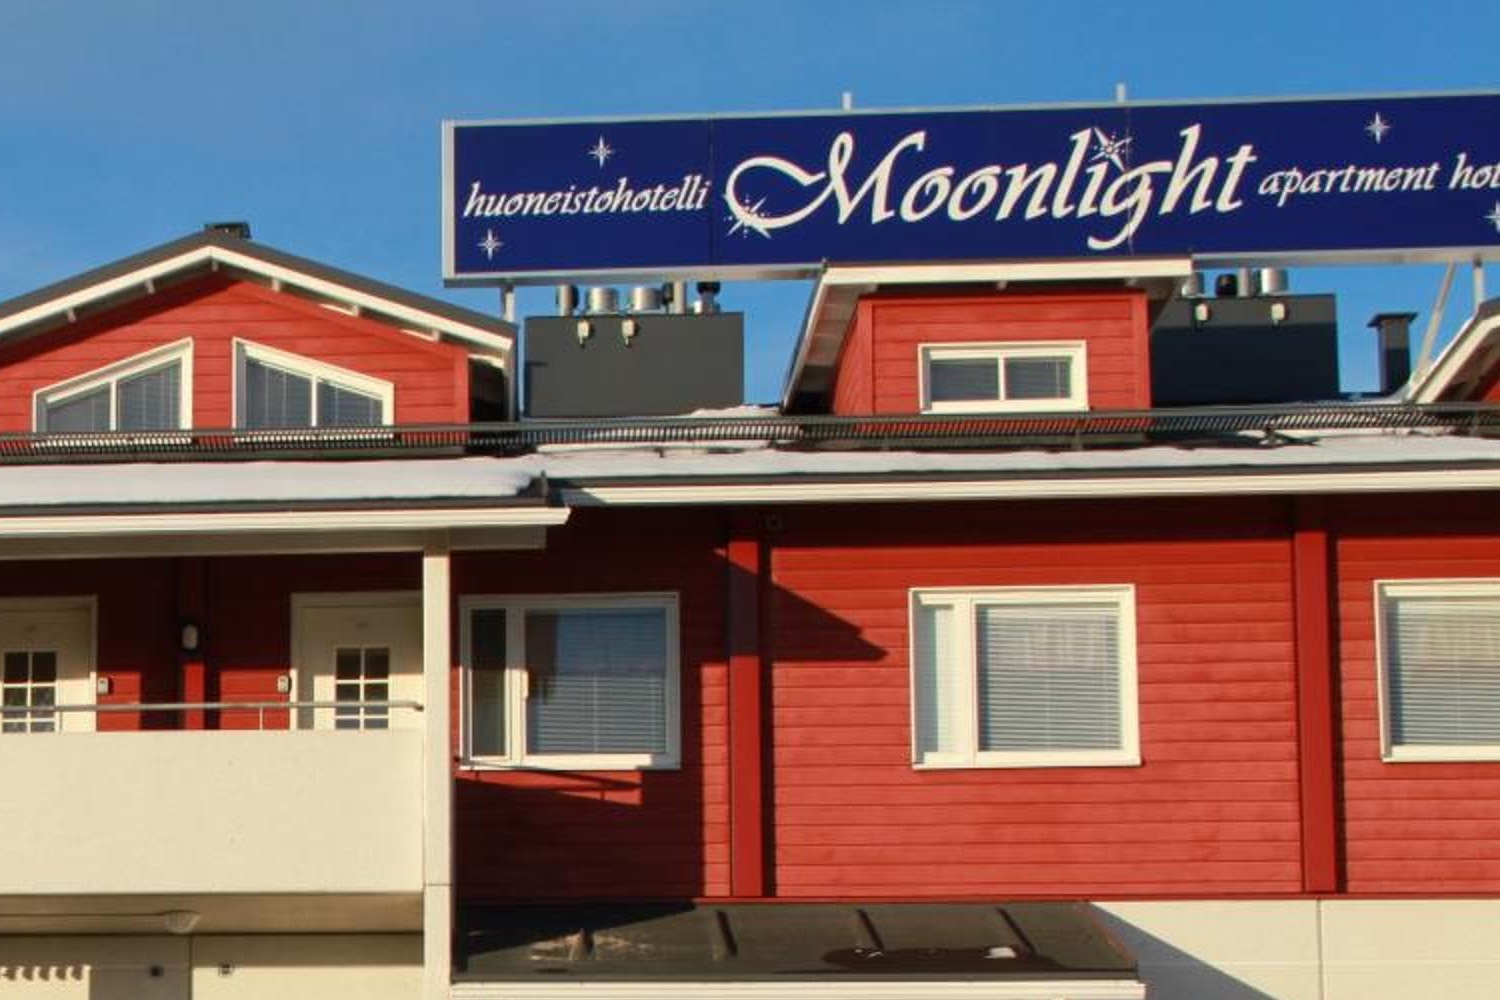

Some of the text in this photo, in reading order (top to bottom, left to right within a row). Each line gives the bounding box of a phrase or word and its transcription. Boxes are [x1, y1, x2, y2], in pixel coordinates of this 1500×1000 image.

[463, 175, 712, 217] huoneistohotelli
[725, 123, 1257, 250] Moonlight
[1258, 162, 1441, 207] apartment
